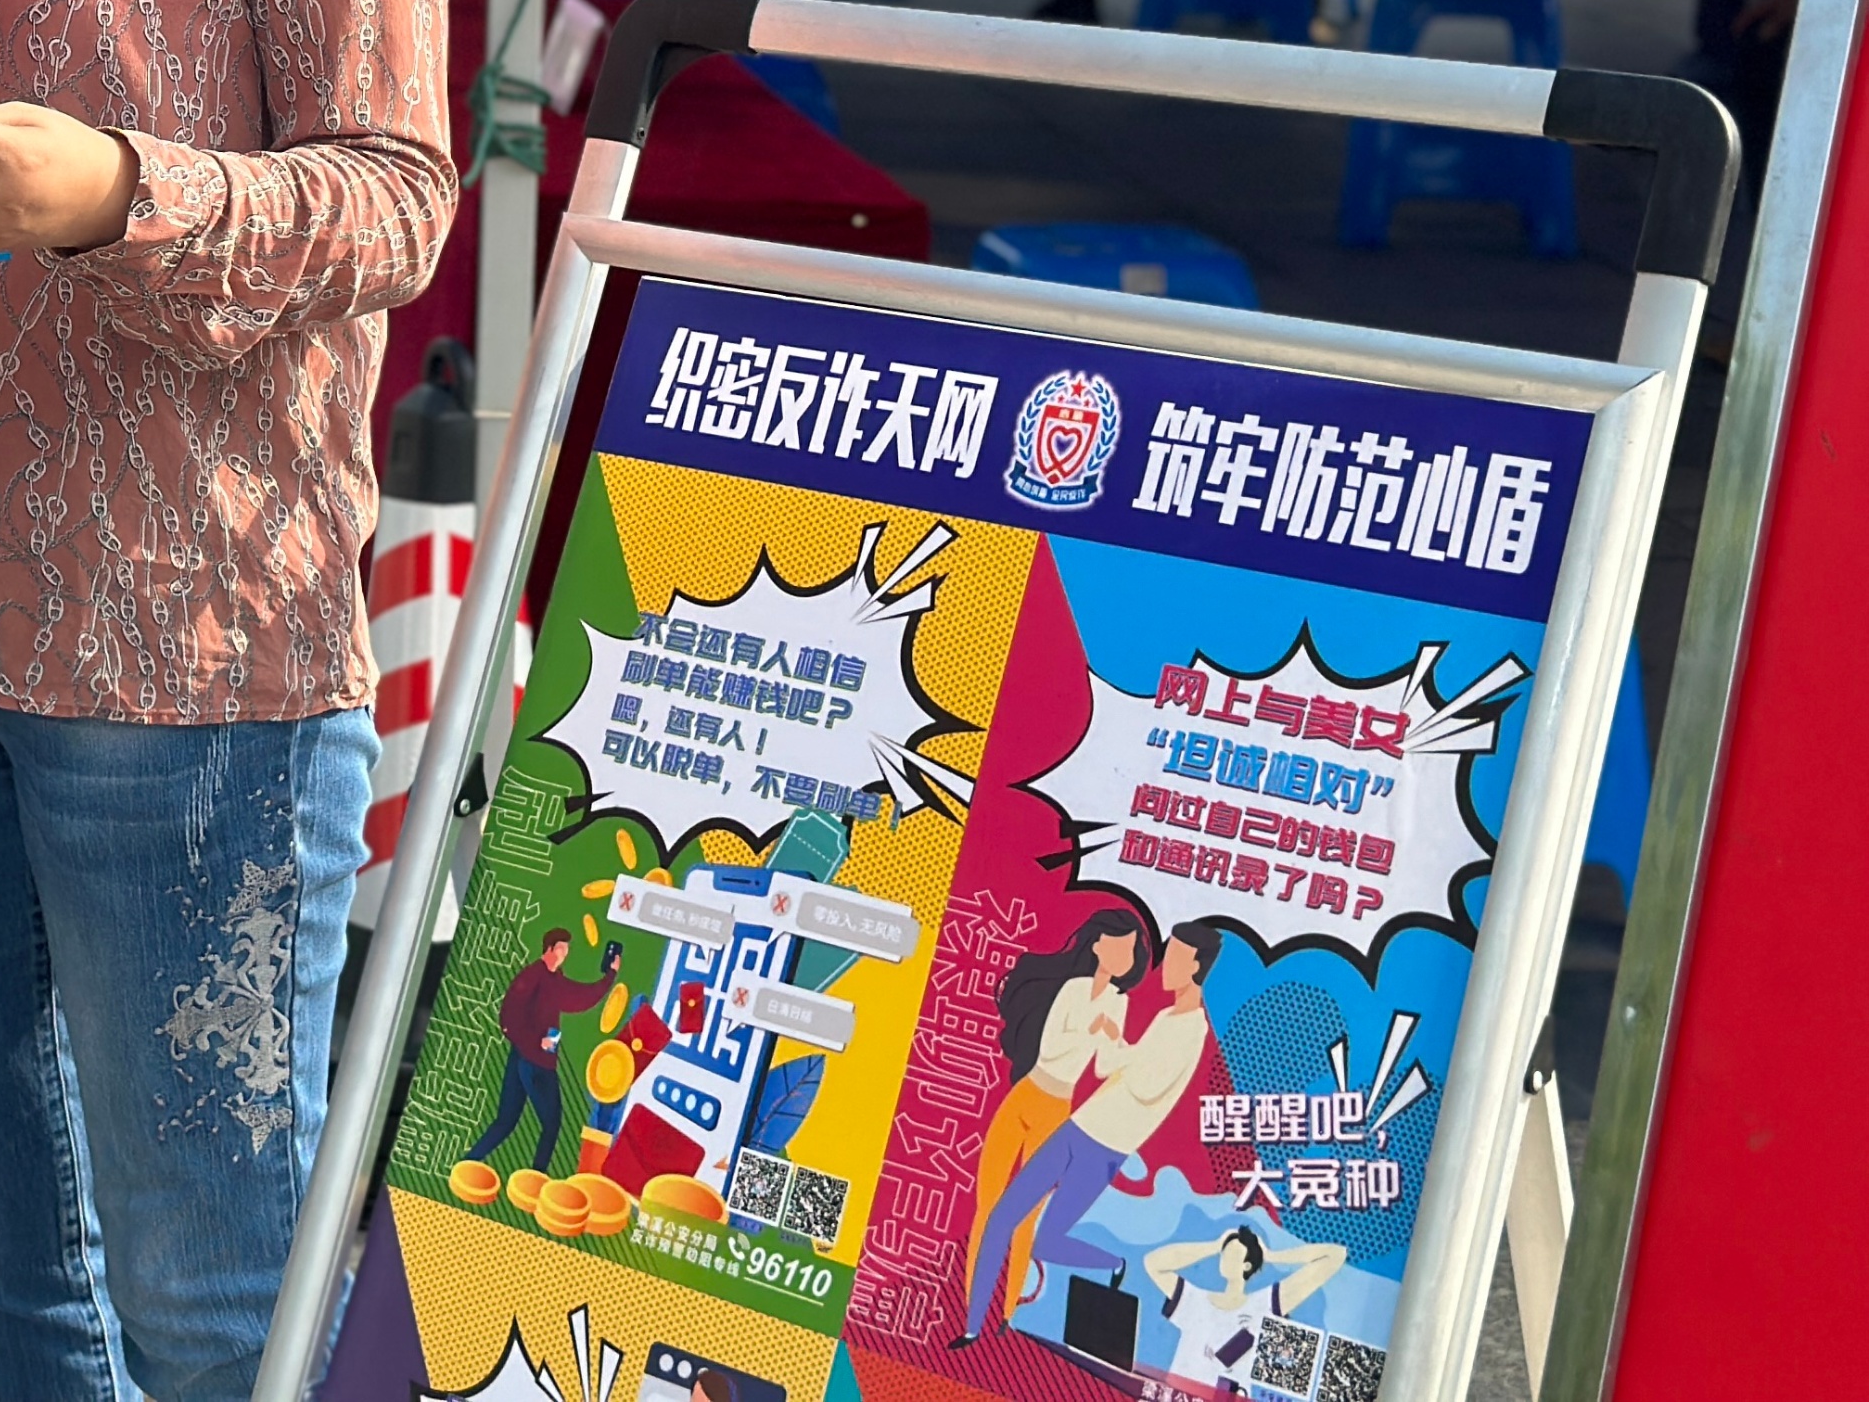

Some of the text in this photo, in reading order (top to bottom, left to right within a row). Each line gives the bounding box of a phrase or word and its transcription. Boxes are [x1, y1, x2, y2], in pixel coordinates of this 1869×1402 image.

[644, 327, 1553, 575] 织密反诈天网 筑牢防范心盾
[620, 650, 854, 730] 刷单能赚钱吧？
[634, 611, 867, 693] 不会还有人相信
[1154, 664, 1411, 759] 网上与美女
[601, 727, 903, 831] 可以脱单，不要刷单！
[1146, 727, 1395, 815] “坦诚相对”
[1130, 783, 1396, 876] 问过自己的钱包
[1119, 829, 1385, 920] 和通讯录了吗？
[390, 765, 572, 1180] 刷单诈骗
[846, 889, 1037, 1345] 裸聊诈骗
[1199, 1092, 1387, 1149] 醒醒吧，
[1231, 1158, 1400, 1211] 大冤种
[630, 1228, 740, 1278] 反诈预警劝阻专线
[637, 1211, 718, 1252] 梁溪公安分局
[746, 1247, 833, 1298] 96110
